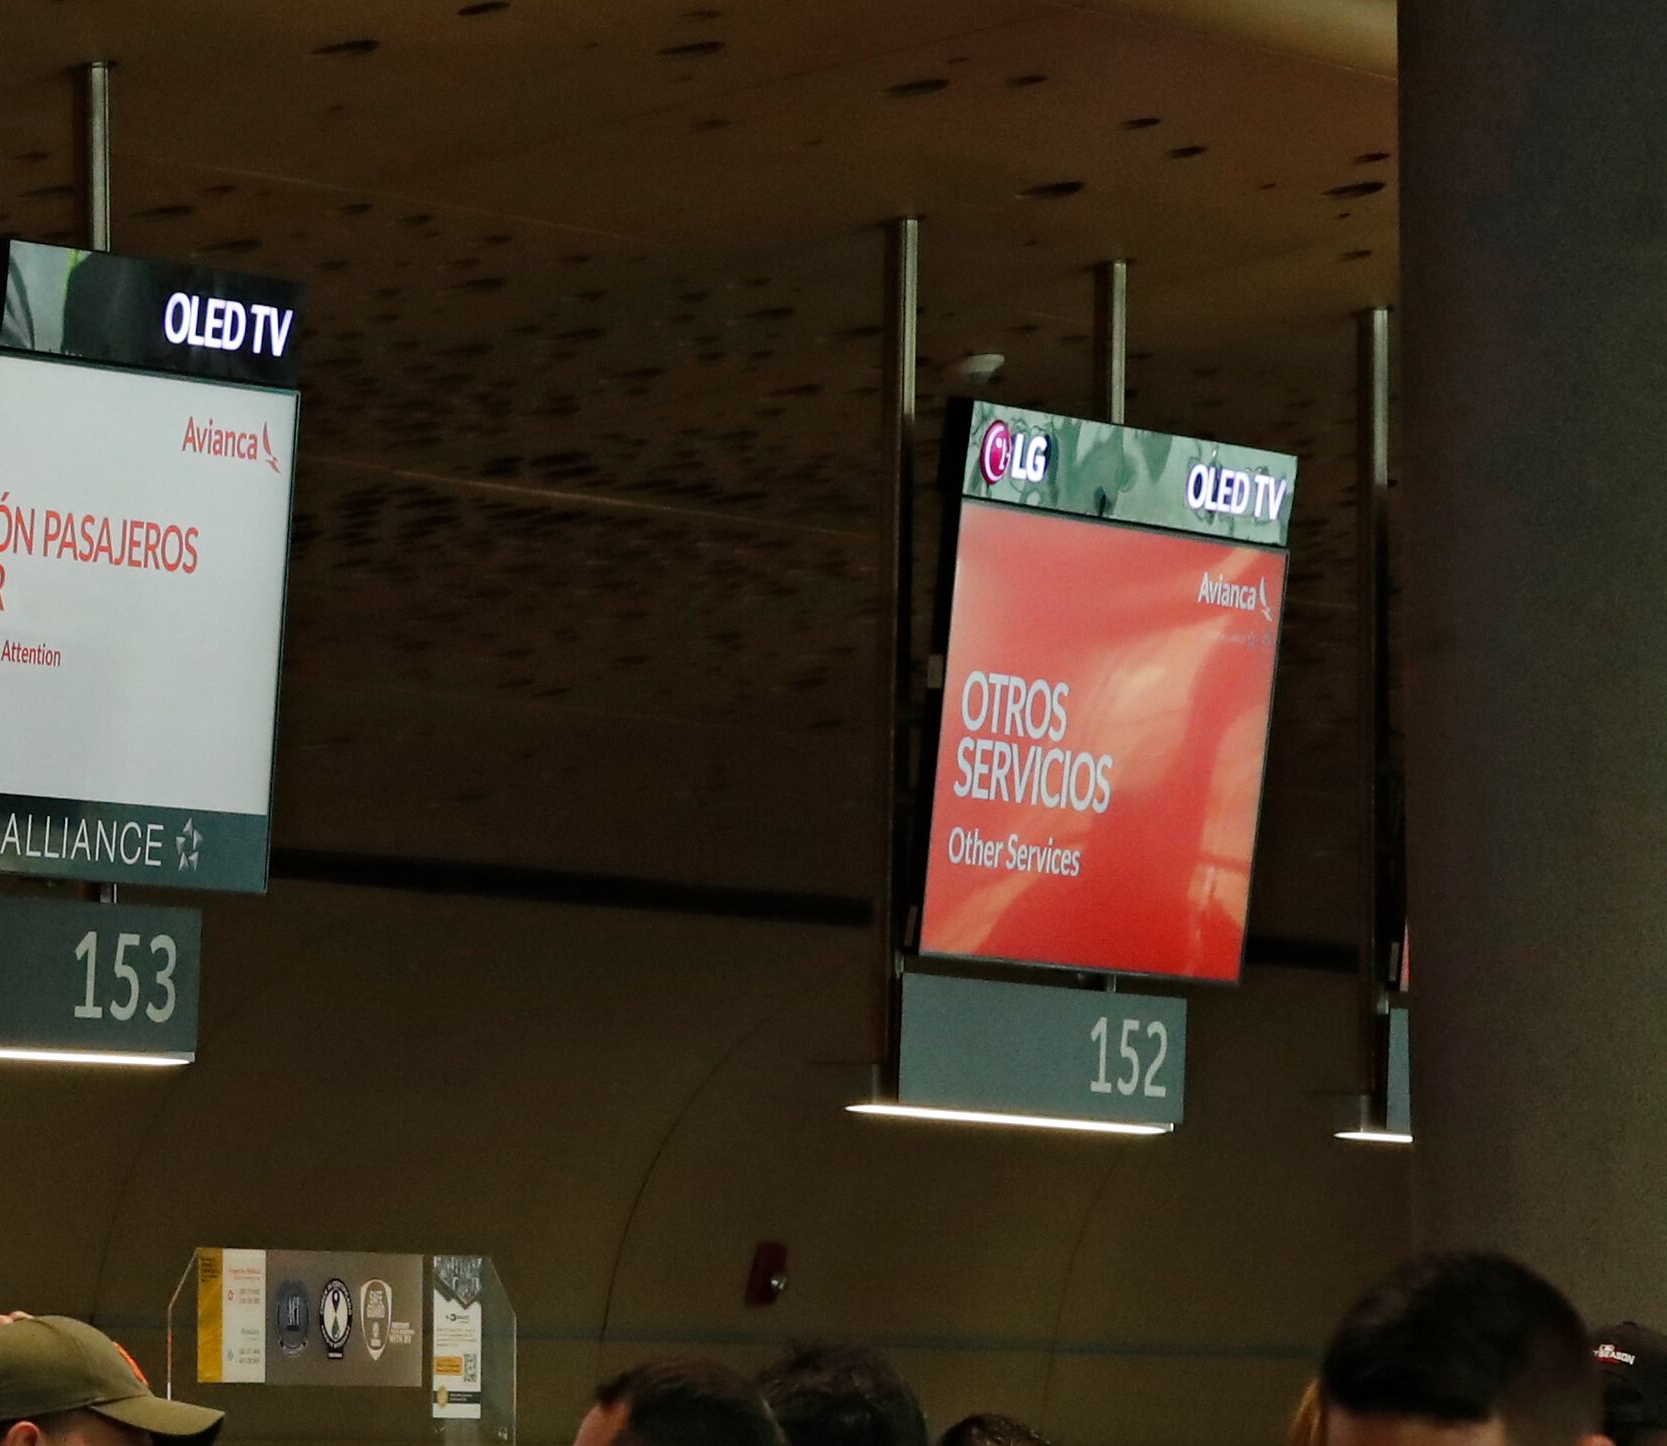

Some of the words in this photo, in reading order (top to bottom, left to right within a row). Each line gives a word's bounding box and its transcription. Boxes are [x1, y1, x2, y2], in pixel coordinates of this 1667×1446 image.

[164, 292, 247, 353] OLED
[248, 303, 294, 360] TV
[182, 415, 259, 464] Avianca
[1011, 434, 1048, 484] LG
[1186, 463, 1252, 516] OLED
[1251, 473, 1288, 522] TV
[44, 510, 199, 576] PASAJEROS
[1197, 571, 1258, 610] Avianca
[1, 640, 62, 668] Attention
[960, 669, 1070, 743] OTROS
[952, 736, 1113, 814] SERVICIOS
[2, 816, 165, 868] ALLIANCE
[948, 825, 1005, 871] Other
[1005, 833, 1080, 880] Services
[74, 929, 178, 1024] 153
[1090, 1015, 1169, 1099] 152
